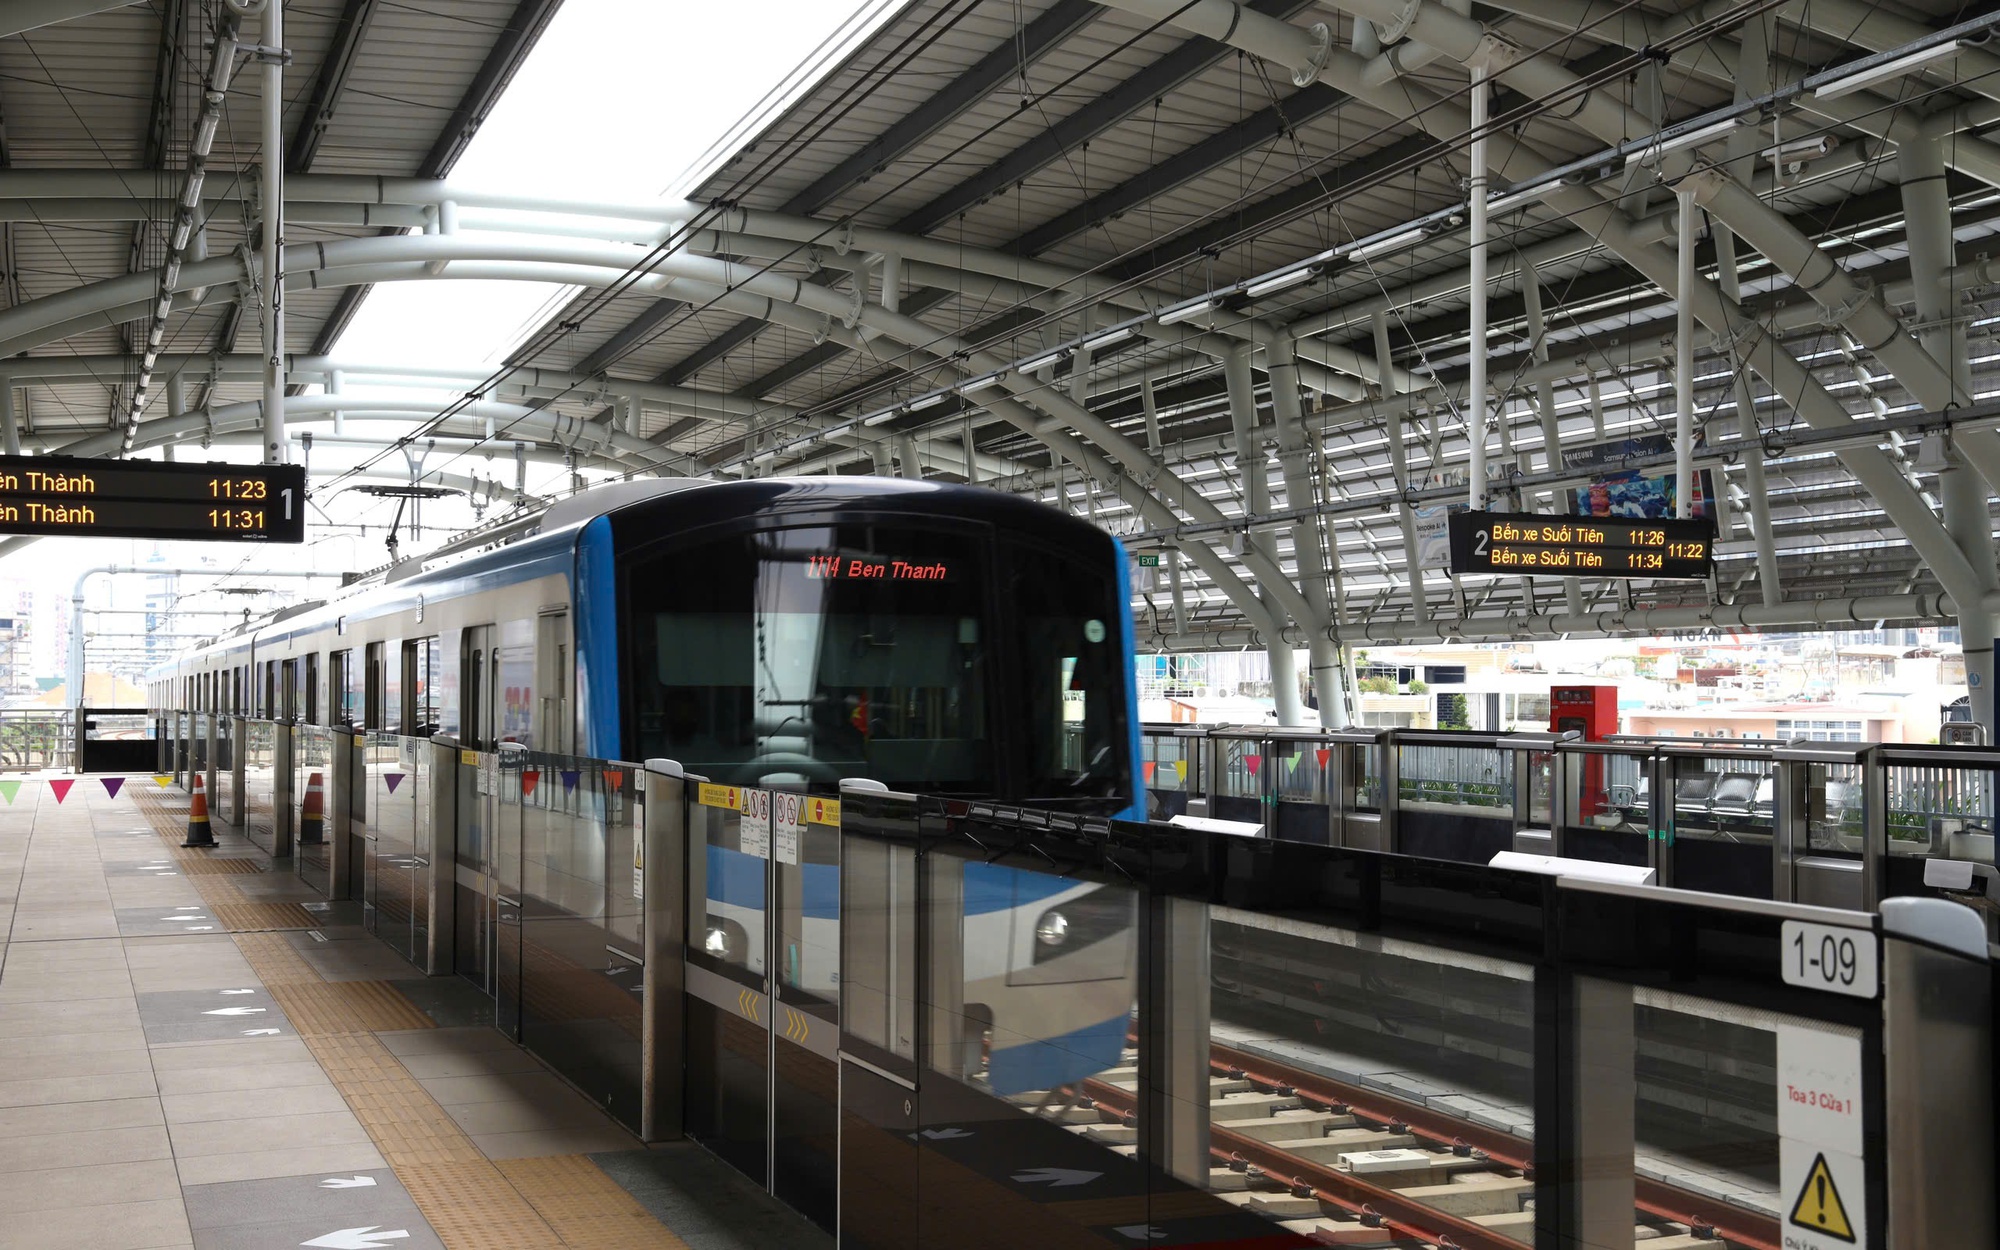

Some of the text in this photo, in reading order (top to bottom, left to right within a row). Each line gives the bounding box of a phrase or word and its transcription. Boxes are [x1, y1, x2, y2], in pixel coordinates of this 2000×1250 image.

[1565, 450, 1594, 461] SAMSUNG
[26, 472, 95, 493] Thành
[209, 479, 266, 499] 11:23
[26, 503, 95, 524] Thành
[209, 509, 264, 529] 11:31
[280, 488, 292, 520] 1
[1474, 529, 1488, 556] 2
[1492, 522, 1665, 545] Bến xe Suối Tiên 11:26
[1141, 556, 1156, 566] EXIT
[1491, 546, 1663, 568] Bến xe Suối Tiên 11:34
[1668, 543, 1703, 558] 11:22
[808, 556, 946, 579] 1114 Ben Thanh
[1793, 930, 1857, 986] 1-09
[1787, 1085, 1807, 1104] Toa
[1809, 1090, 1817, 1106] 3
[1846, 1099, 1851, 1115] 1
